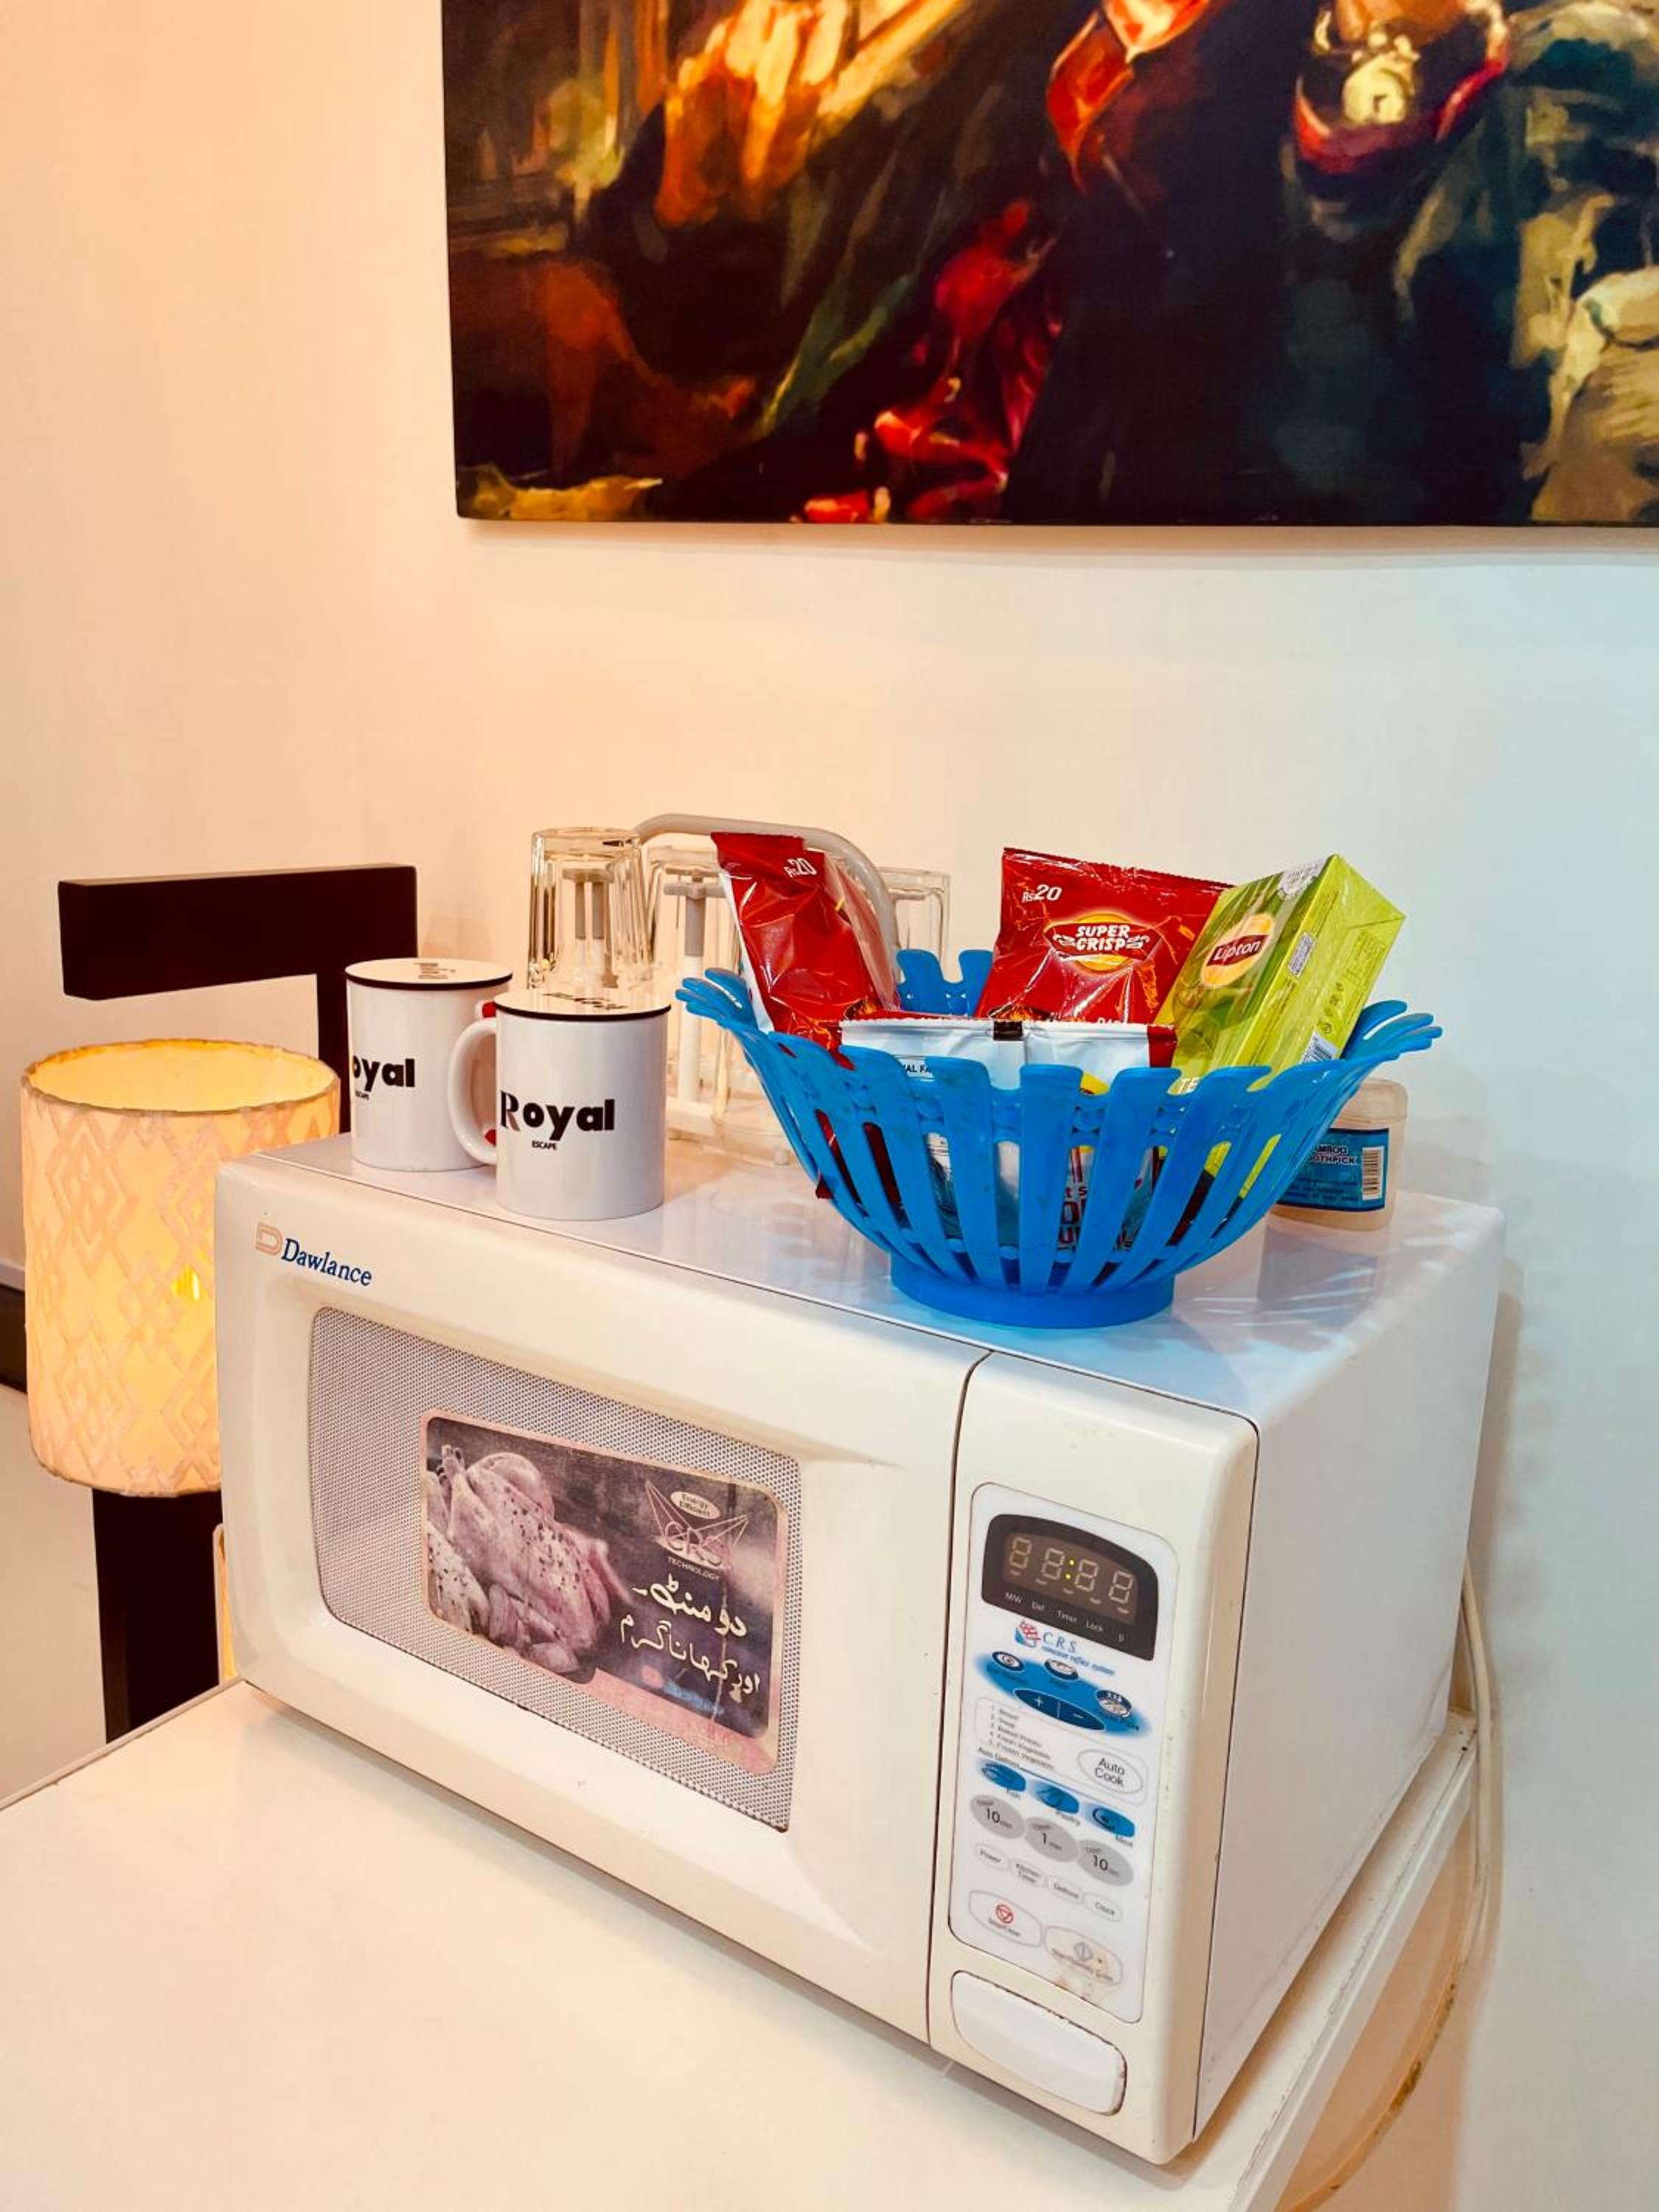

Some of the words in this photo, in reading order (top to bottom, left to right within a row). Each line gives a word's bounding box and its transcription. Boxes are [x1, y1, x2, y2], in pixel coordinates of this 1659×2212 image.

[1076, 924, 1130, 937] SUPER
[1076, 937, 1127, 951] CRISP
[1212, 939, 1262, 961] Lipton
[352, 1055, 415, 1093] oyal
[500, 1090, 615, 1141] Royal
[532, 1141, 557, 1150] ESCAPE
[281, 1237, 372, 1287] Dawlance
[669, 1557, 720, 1582] TECHNOLOGY
[1098, 1757, 1126, 1775] Auto
[1095, 1767, 1124, 1787] Cook
[985, 1807, 1001, 1824] 10
[1092, 1854, 1109, 1871] 10
